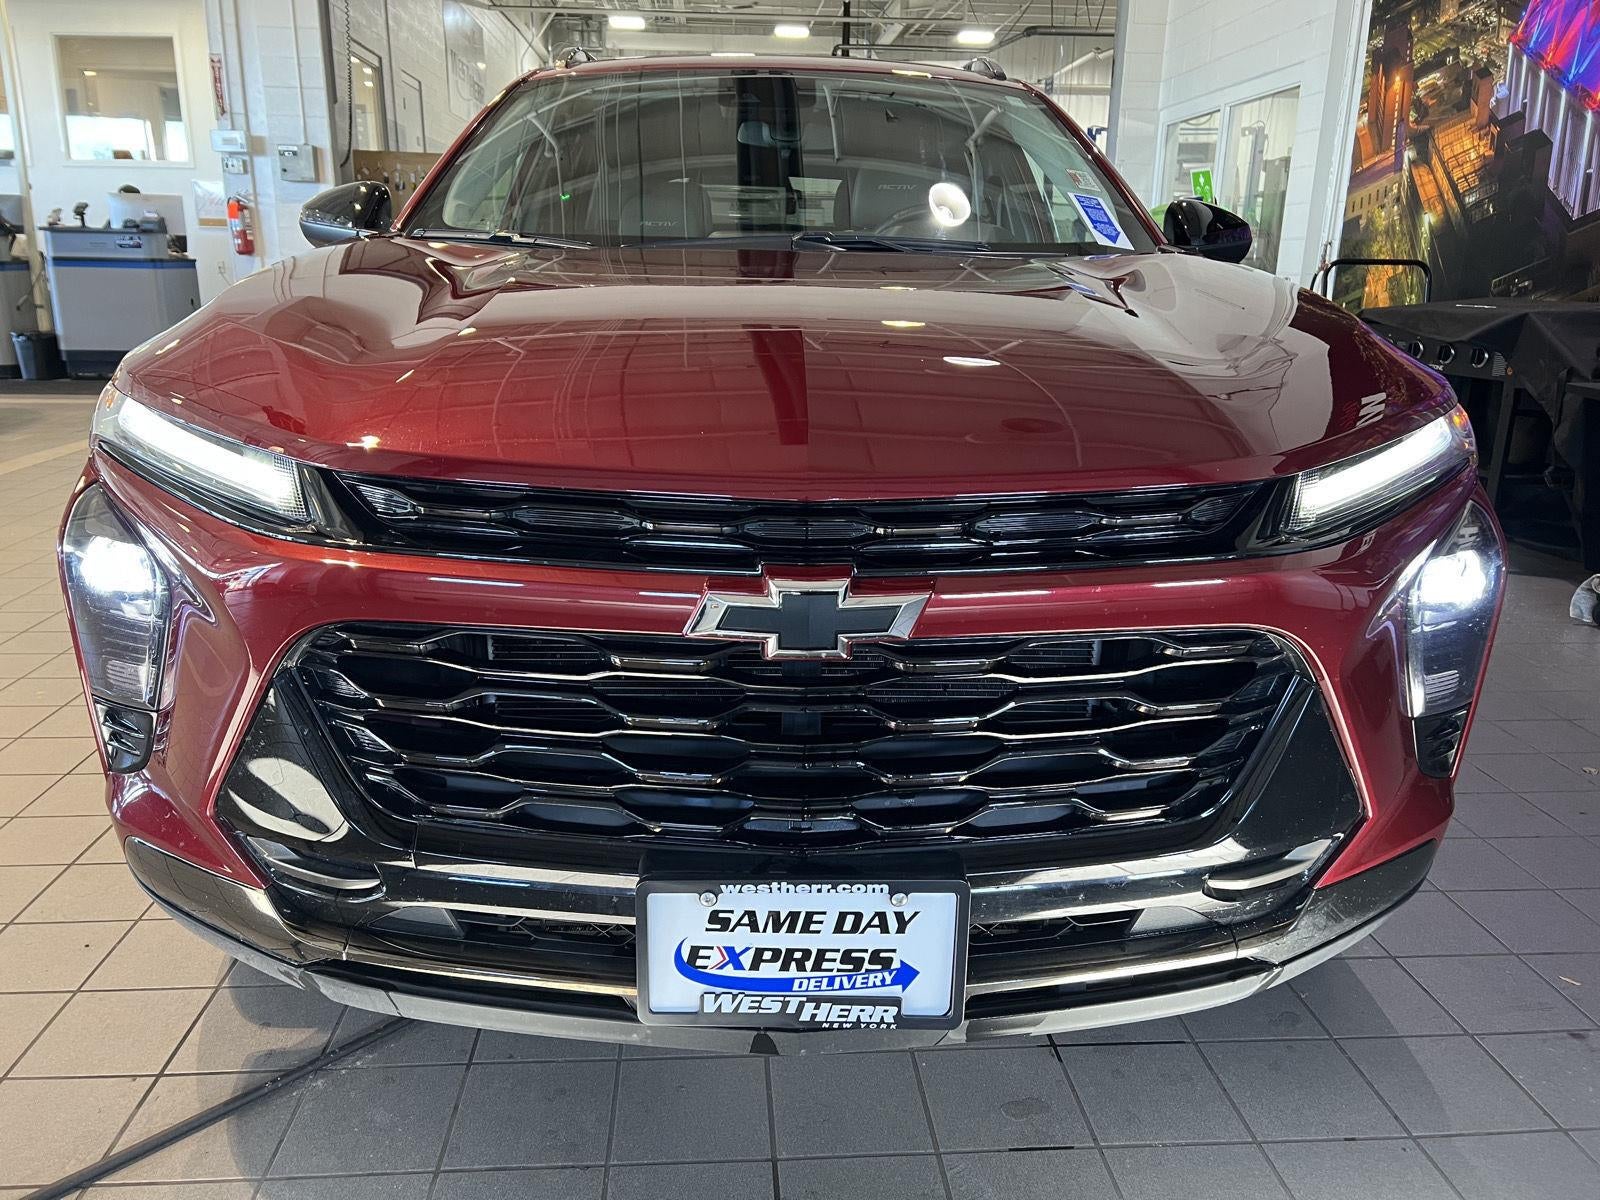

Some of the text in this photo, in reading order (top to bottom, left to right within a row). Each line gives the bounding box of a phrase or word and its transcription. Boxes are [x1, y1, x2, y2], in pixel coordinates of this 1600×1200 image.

[720, 881, 889, 894] westherr.com
[705, 909, 921, 934] SAME DAY
[686, 945, 897, 973] EXPRESS
[792, 970, 897, 991] DELIVERY
[703, 993, 898, 1023] WEST HERR
[860, 1022, 898, 1030] YORK
